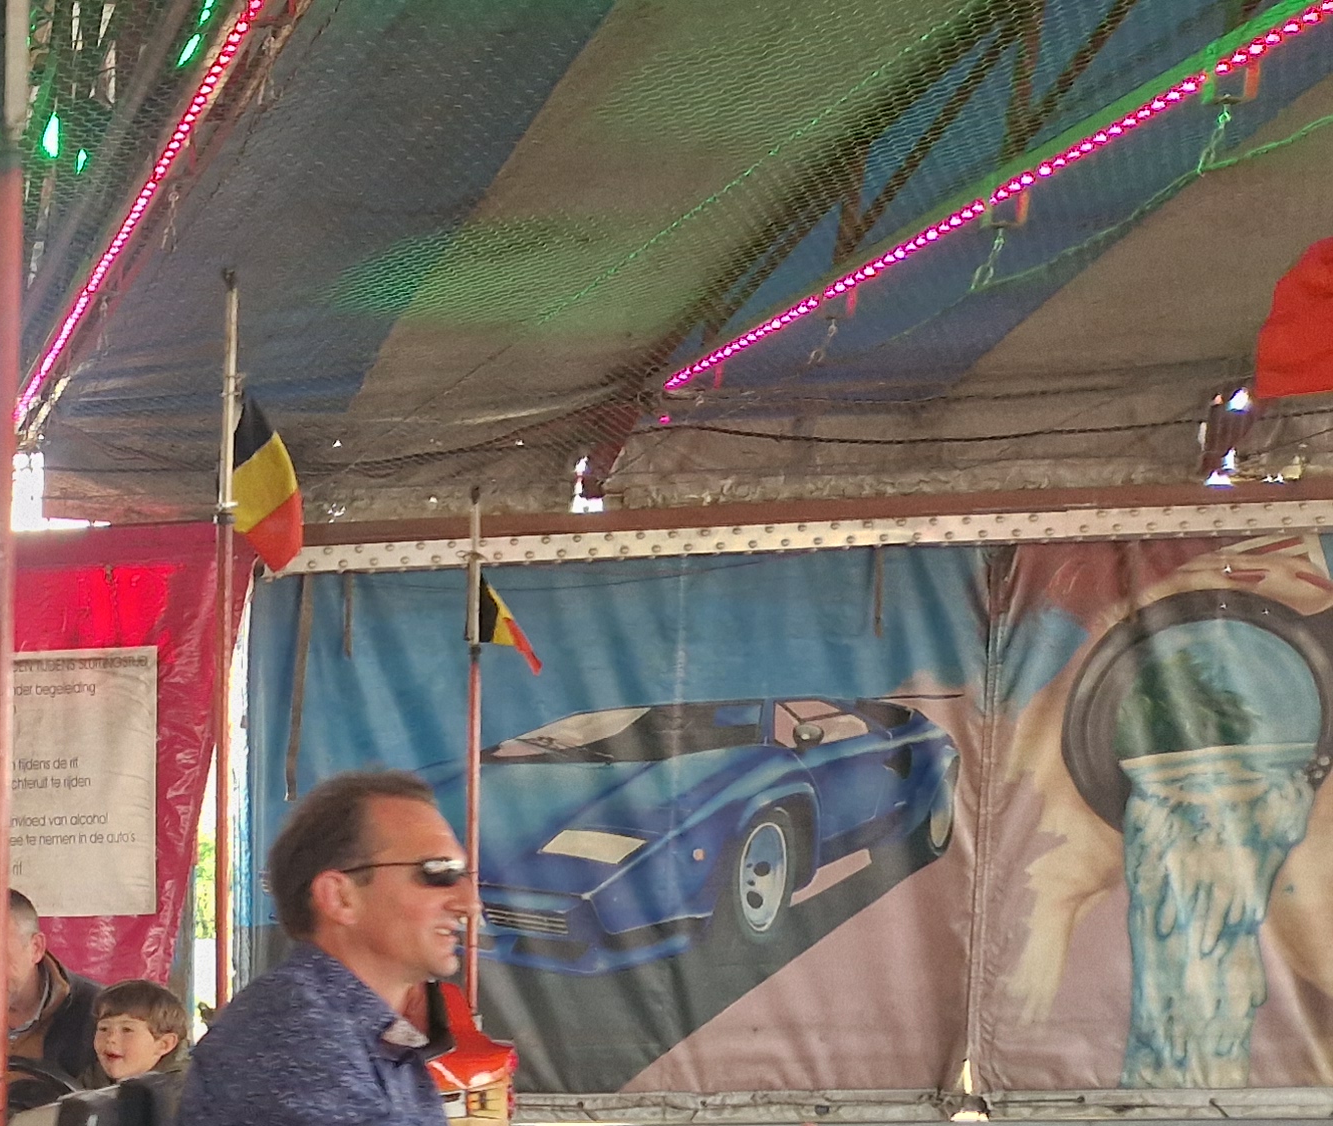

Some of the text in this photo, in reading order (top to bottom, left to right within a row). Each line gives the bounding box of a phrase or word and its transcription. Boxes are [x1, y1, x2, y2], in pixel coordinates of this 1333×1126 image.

[35, 682, 96, 698] begeleiding
[18, 757, 50, 772] tijdens
[53, 757, 67, 769] de
[69, 756, 79, 769] rit
[11, 777, 48, 790] chteruit
[51, 777, 61, 788] te
[63, 776, 91, 790] rijden
[10, 815, 46, 827] nvloed
[48, 816, 68, 826] van
[70, 812, 109, 825] alcohol
[26, 834, 36, 846] te
[39, 834, 76, 845] nemen
[78, 832, 87, 844] in
[90, 832, 104, 844] de
[106, 831, 136, 844] auto's
